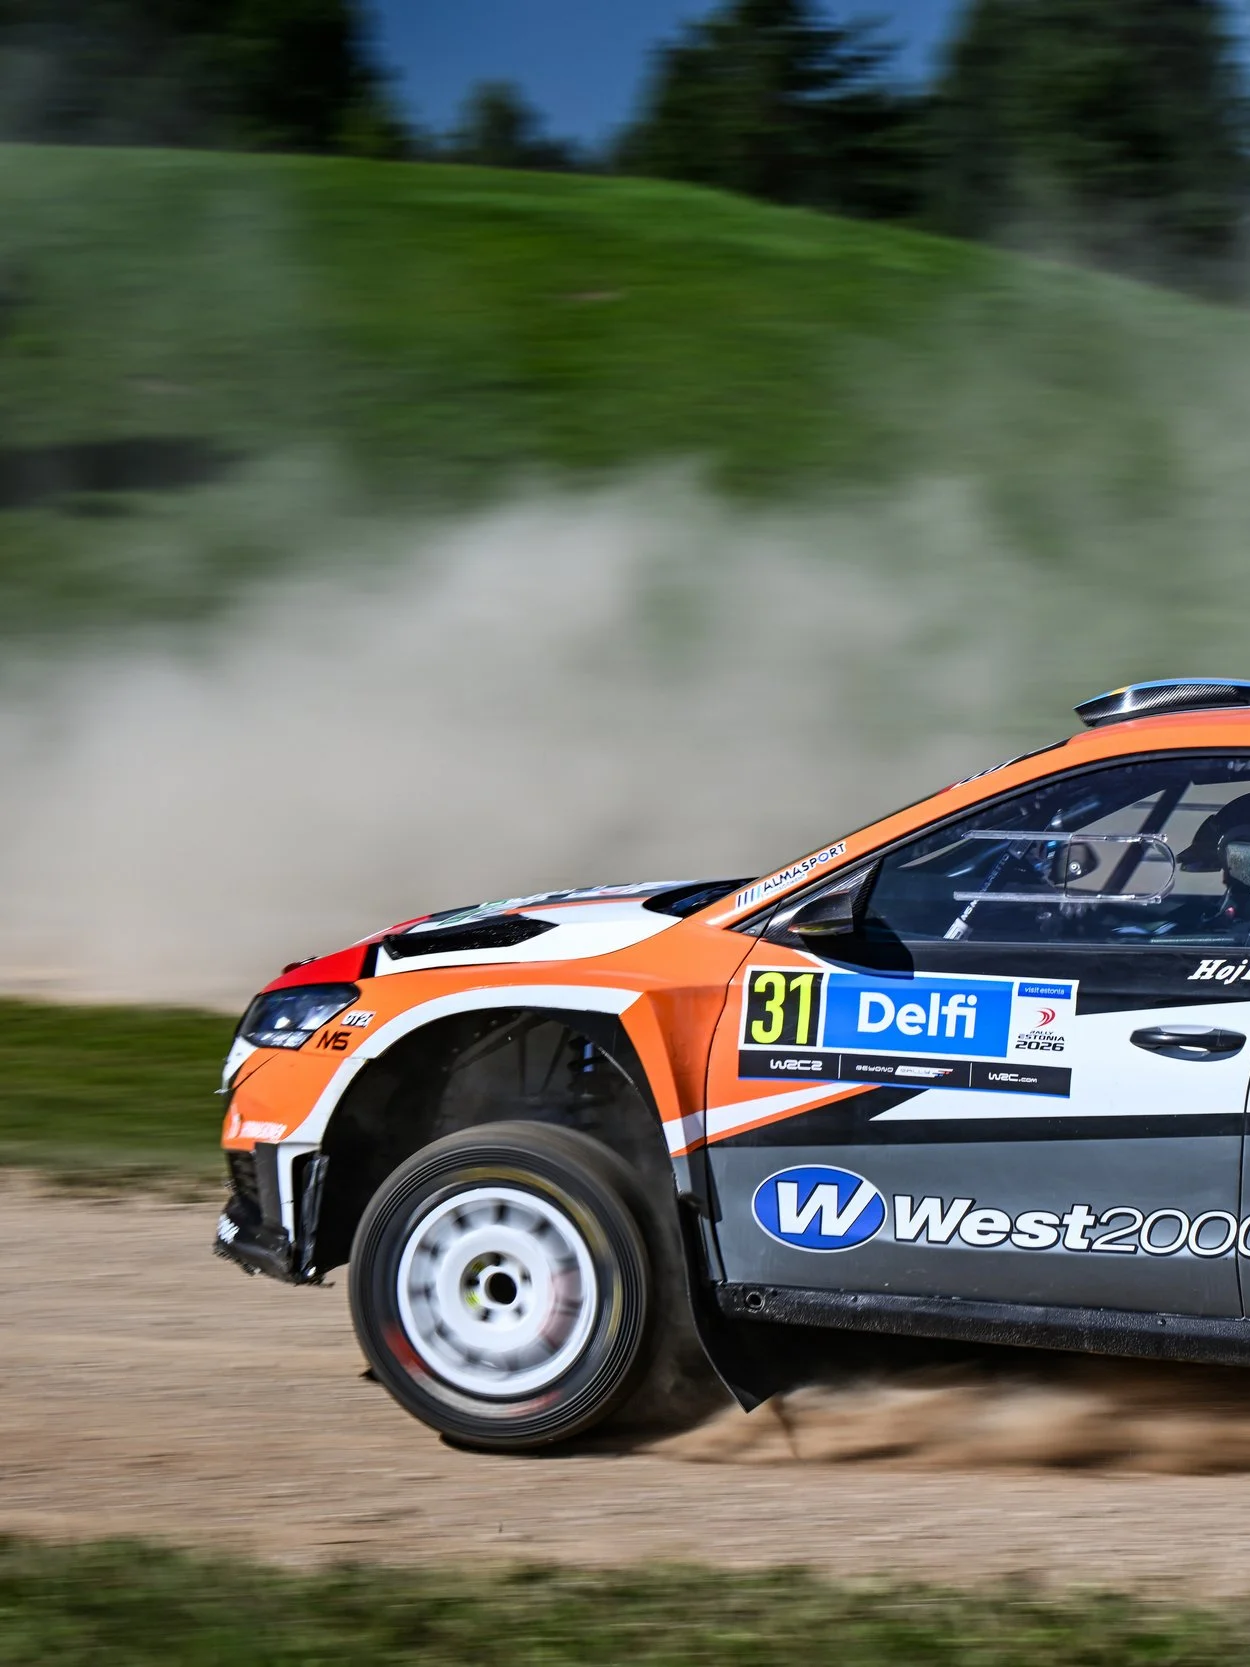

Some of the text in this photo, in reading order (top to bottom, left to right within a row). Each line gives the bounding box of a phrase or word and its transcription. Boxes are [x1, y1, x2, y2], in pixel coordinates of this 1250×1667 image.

[763, 843, 846, 893] ALMASPORT
[751, 971, 815, 1045] 31
[856, 991, 978, 1039] Delfi
[1015, 1040, 1065, 1052] 2026
[1018, 1033, 1065, 1042] ESTONIA
